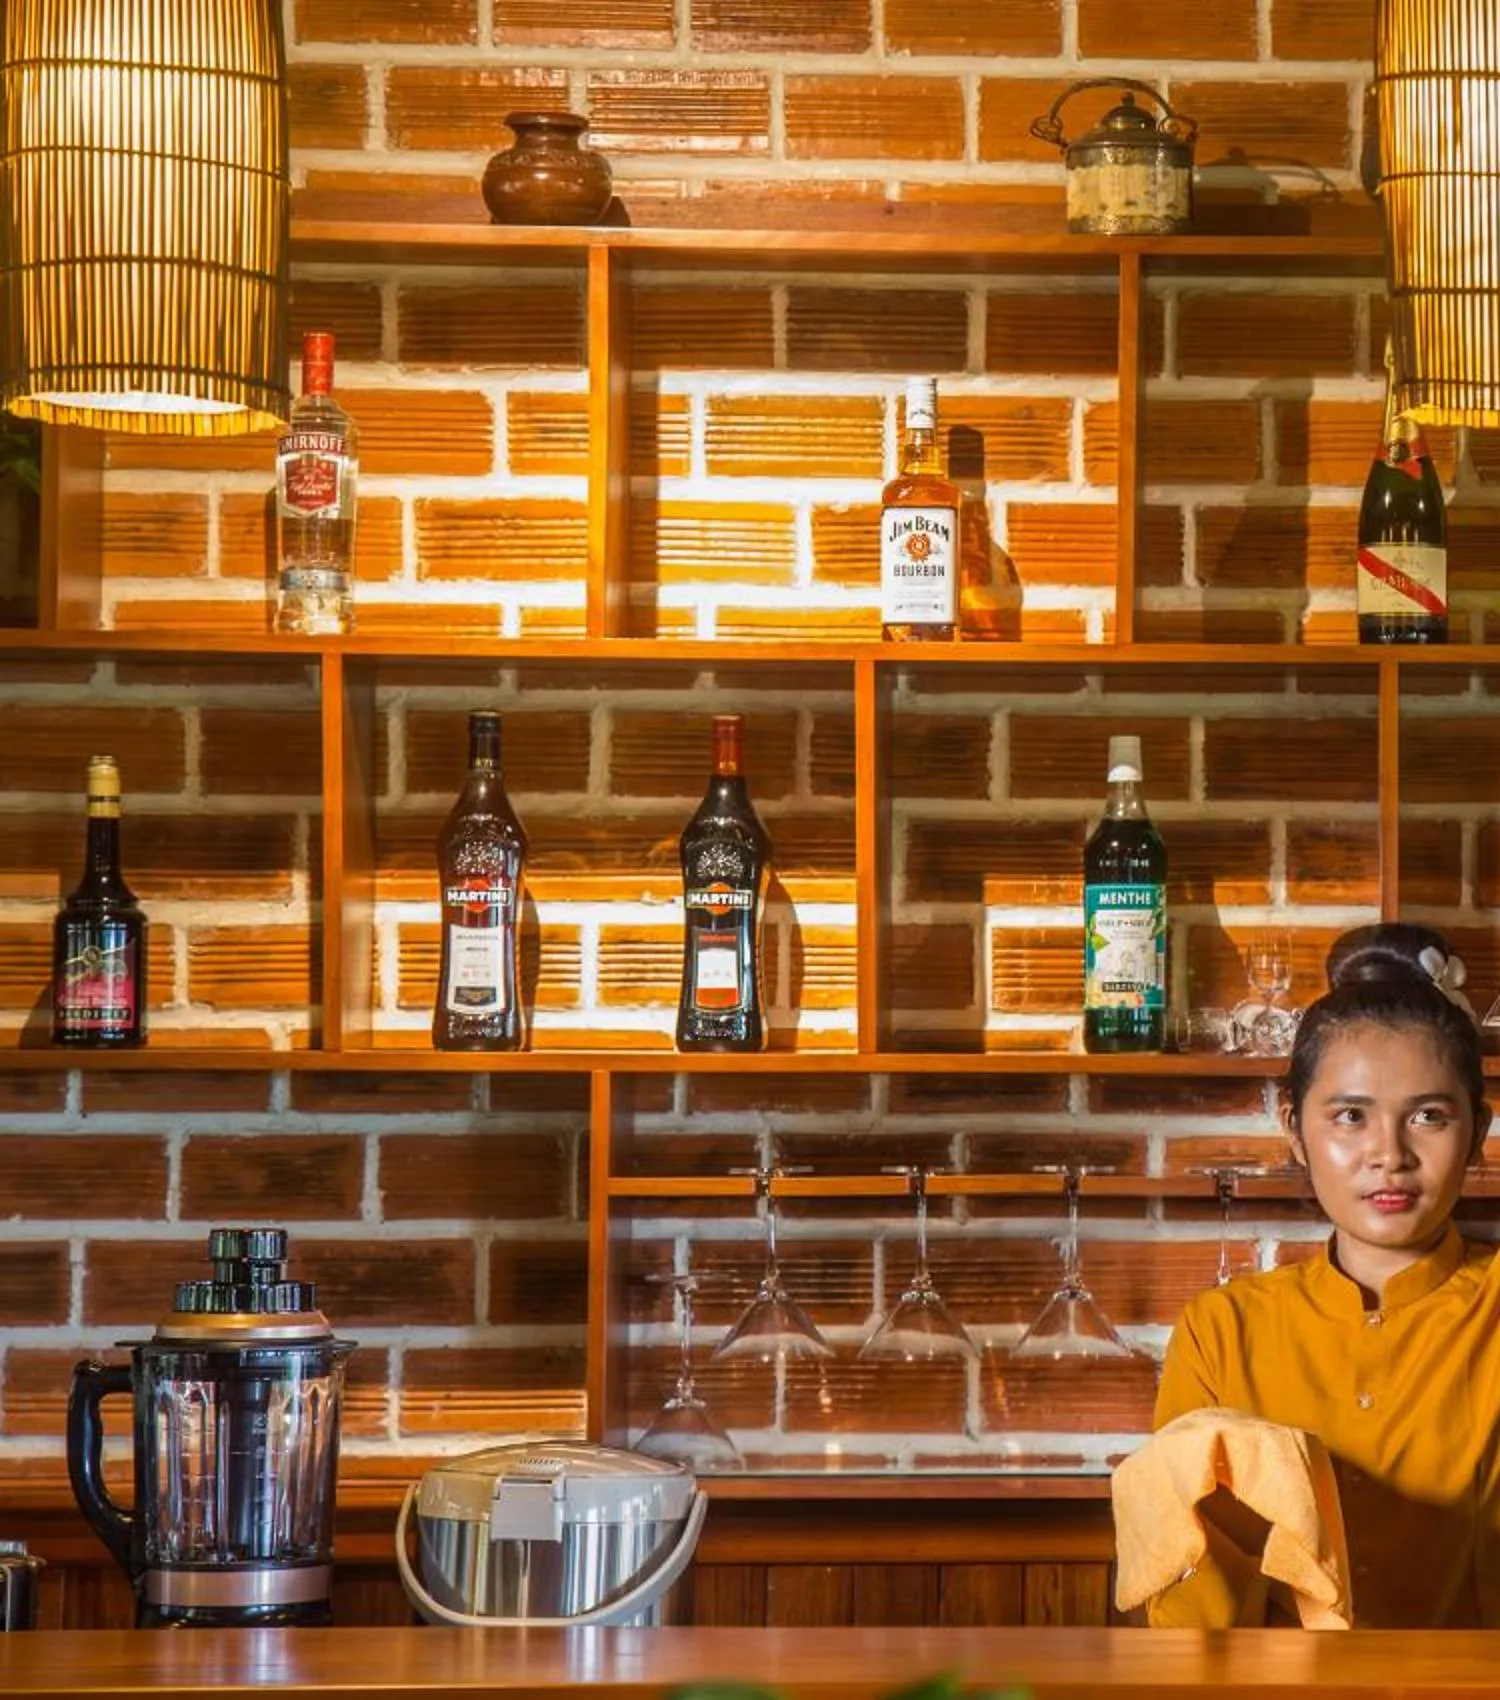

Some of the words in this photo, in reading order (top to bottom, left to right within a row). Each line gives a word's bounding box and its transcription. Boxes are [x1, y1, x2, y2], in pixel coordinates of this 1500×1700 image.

[889, 520, 913, 543] JIM
[915, 515, 949, 543] BEAM
[893, 563, 945, 577] BOURBON
[446, 889, 507, 902] MARTINI
[690, 892, 749, 905] MARTINI
[1099, 890, 1151, 905] MENTHE
